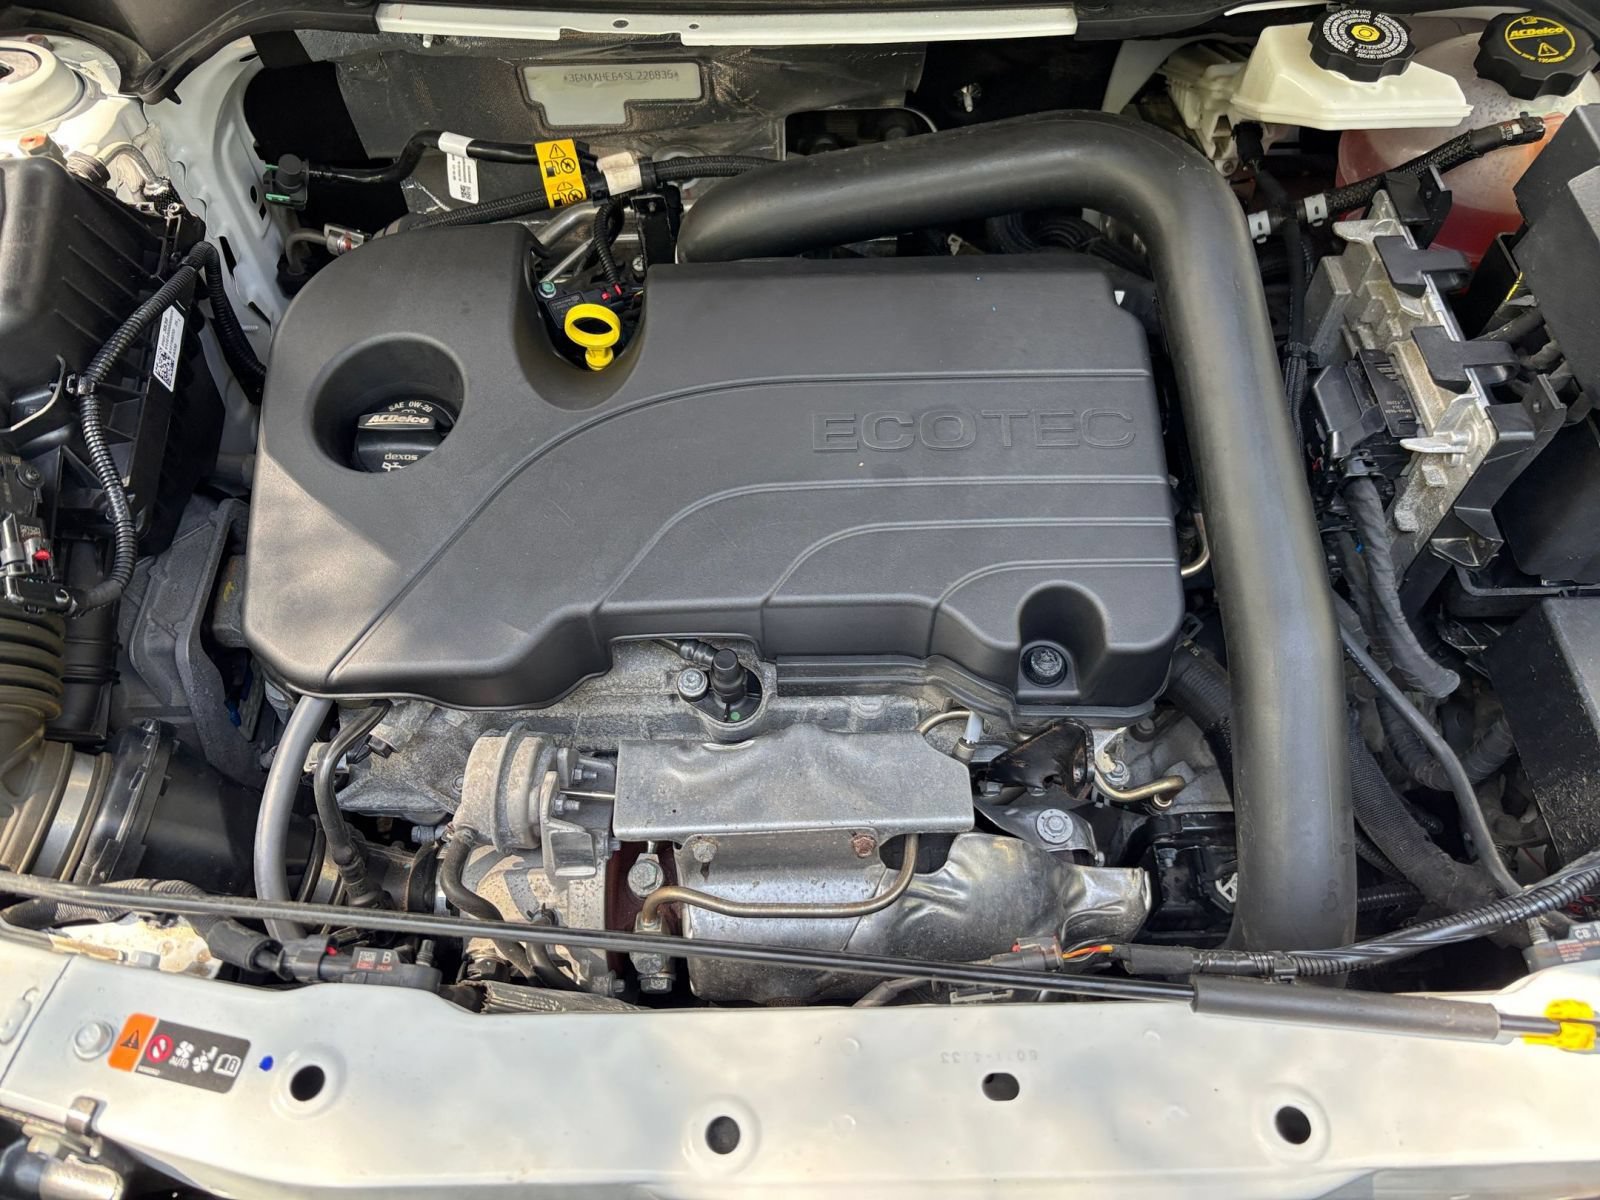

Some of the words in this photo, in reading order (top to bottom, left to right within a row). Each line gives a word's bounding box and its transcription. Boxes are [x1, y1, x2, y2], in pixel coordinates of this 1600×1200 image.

[1509, 26, 1565, 38] ACDelco
[388, 401, 405, 412] SAE
[408, 401, 433, 413] 0W-20
[367, 414, 430, 425] ACDelco
[812, 407, 1136, 452] ECOTEC
[384, 452, 419, 461] dexos
[382, 951, 392, 964] B
[168, 1056, 189, 1070] AUTO
